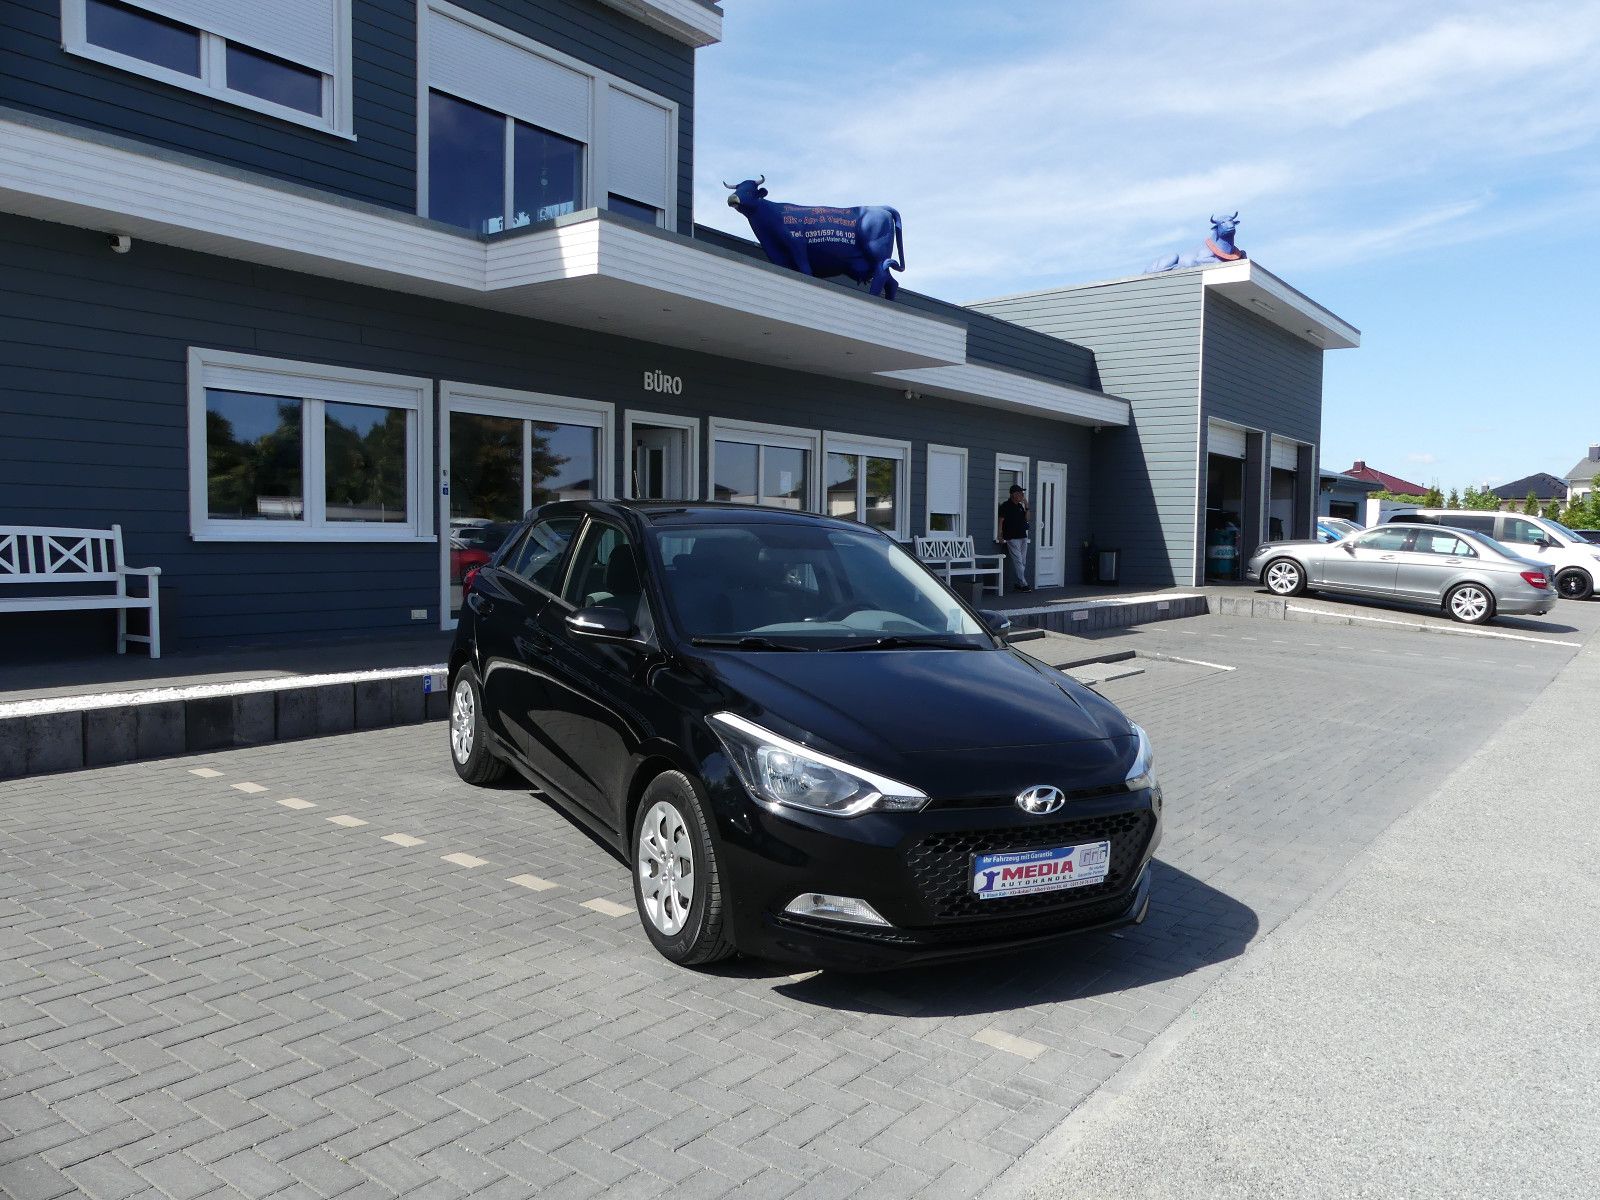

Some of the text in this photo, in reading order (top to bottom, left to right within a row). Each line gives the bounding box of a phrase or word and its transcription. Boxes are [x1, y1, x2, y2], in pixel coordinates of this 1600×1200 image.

[643, 369, 683, 395] BÜRO
[992, 855, 1020, 863] Fahrzeug
[1030, 851, 1053, 859] Garantie
[1001, 860, 1074, 881] MEDIA
[1000, 874, 1073, 888] AUTOHANDEL
